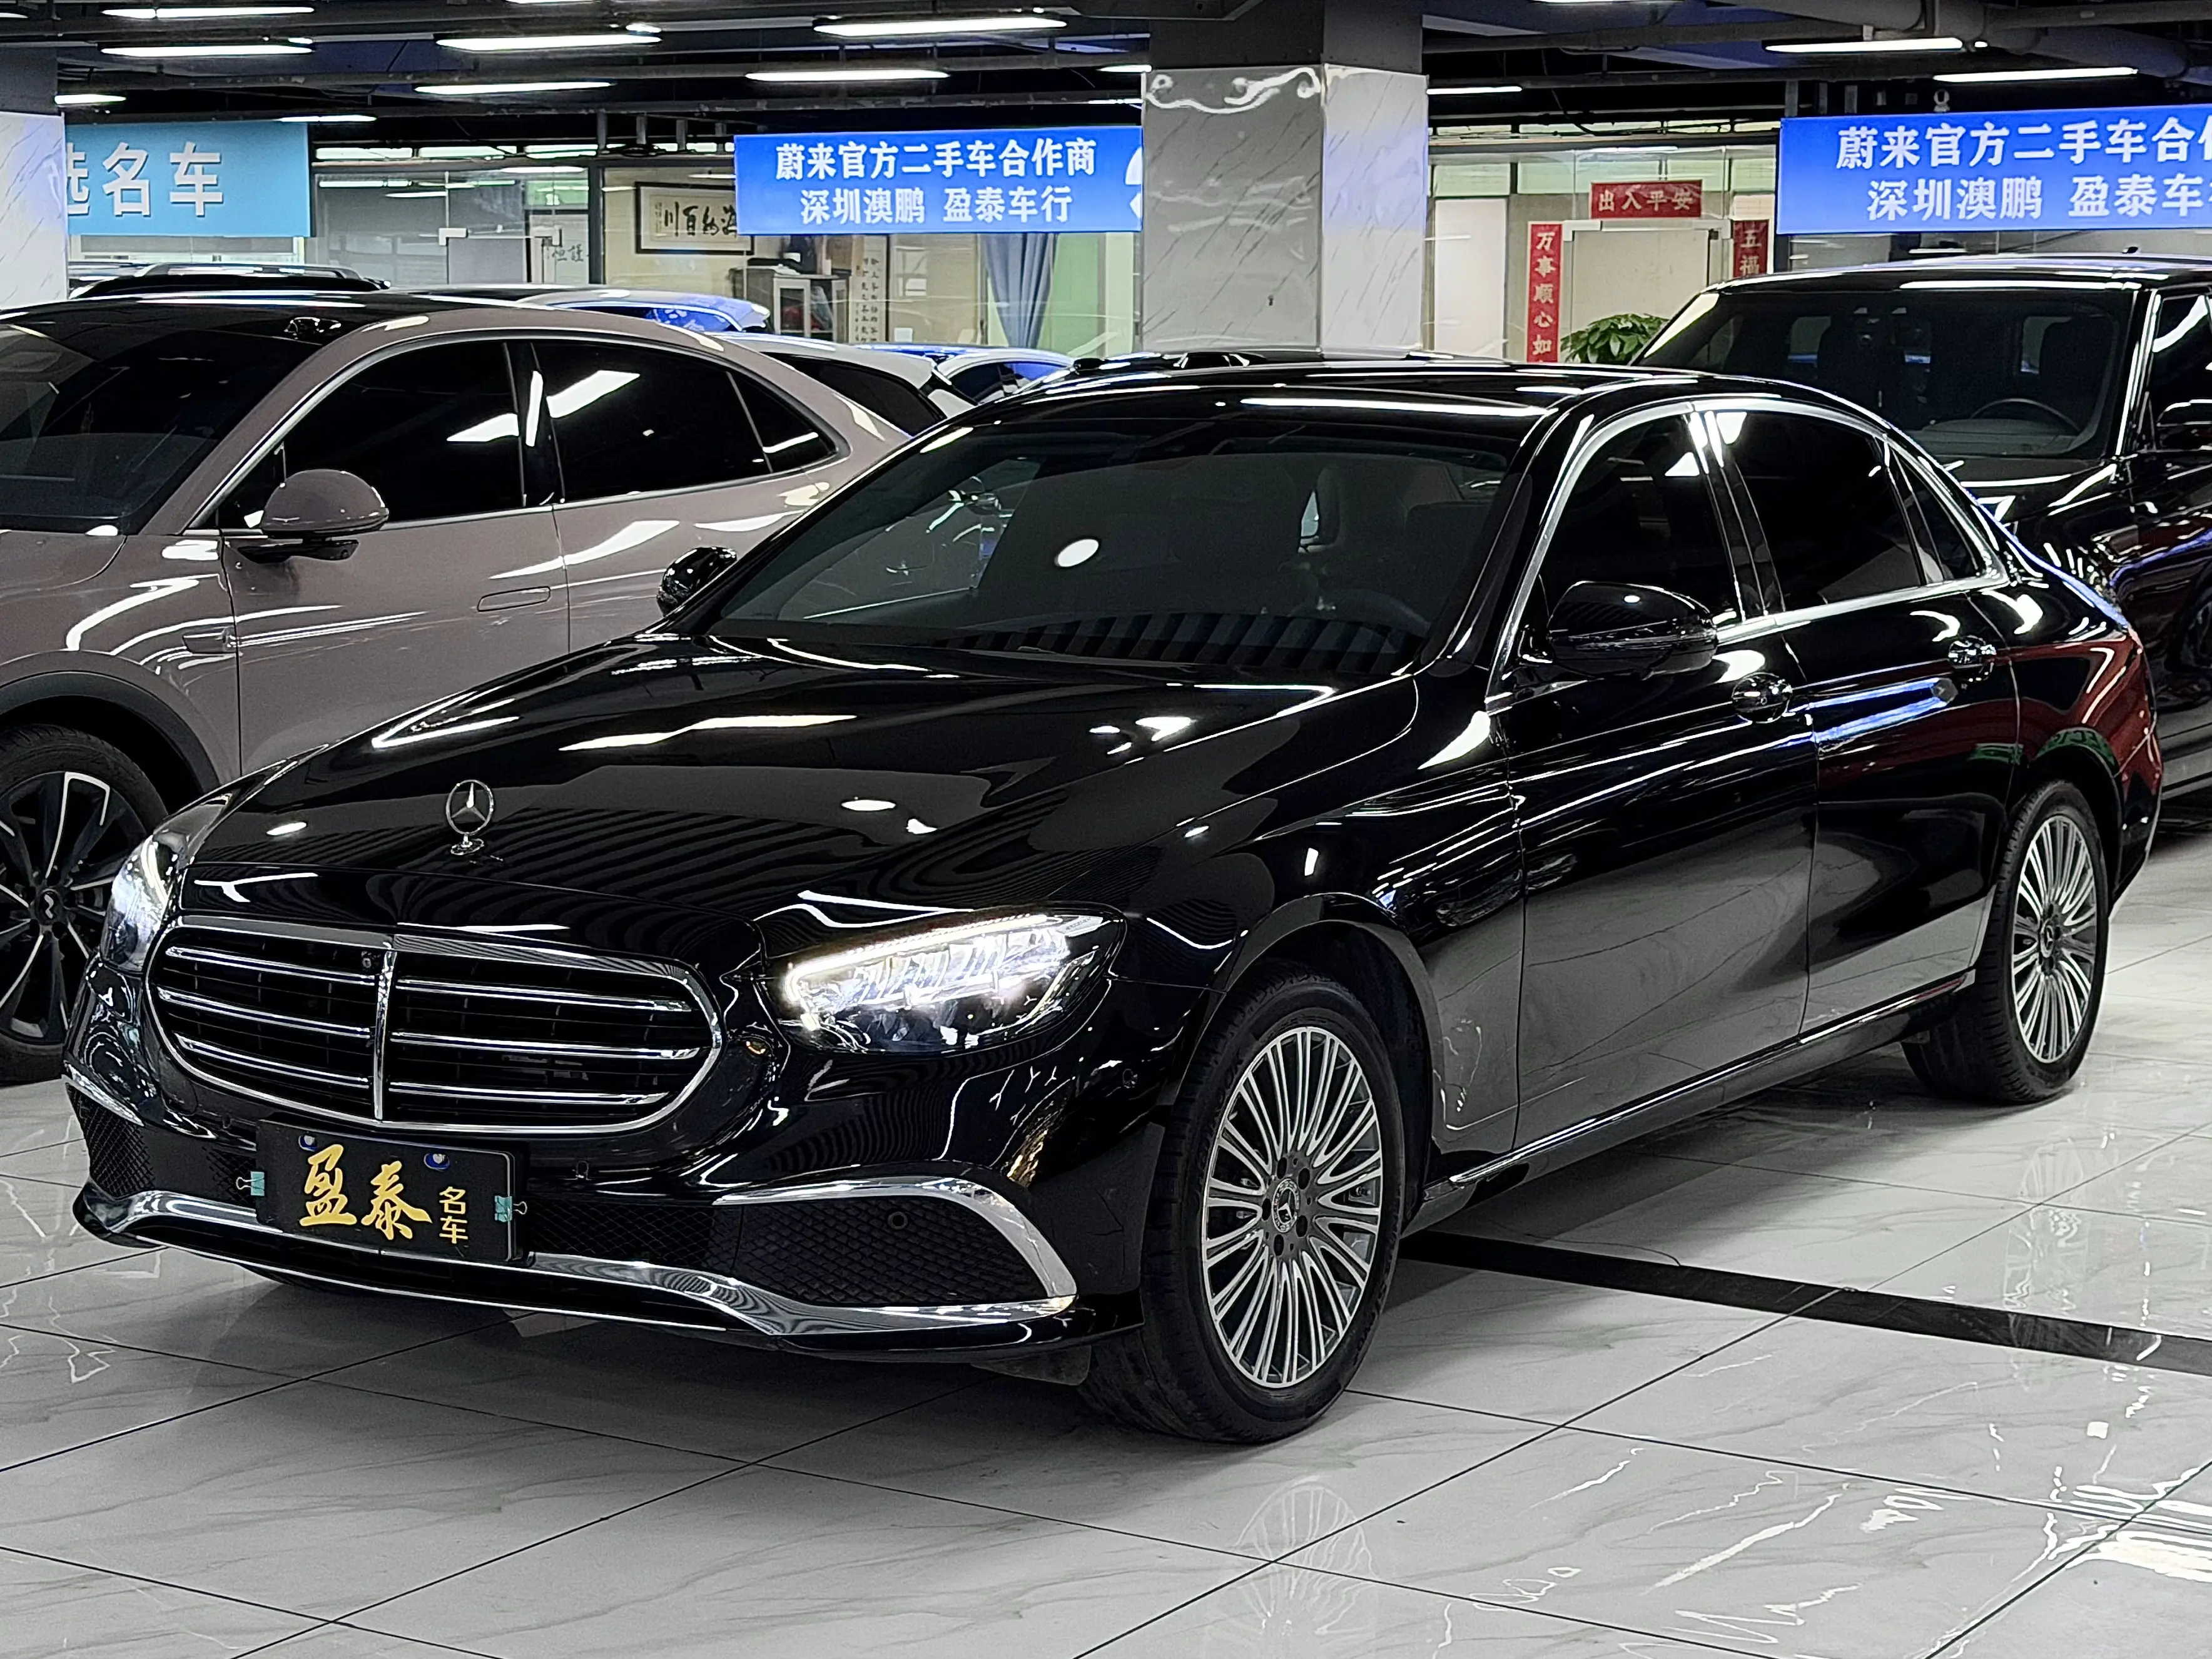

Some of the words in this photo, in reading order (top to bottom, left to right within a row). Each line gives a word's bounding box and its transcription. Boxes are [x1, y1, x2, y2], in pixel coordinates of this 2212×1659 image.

[776, 138, 1097, 180] 蔚来官方二手车合作商
[801, 186, 925, 225] 深圳澳鹏
[943, 185, 1072, 223] 盈泰车行
[1598, 185, 1693, 211] 出入平安
[1867, 176, 2042, 221] 深圳澳鹏
[2068, 173, 2212, 217] 盈泰车
[1740, 230, 1762, 276] 五福
[1532, 231, 1556, 362] 万事顺心如
[300, 1144, 433, 1240] 盈泰
[439, 1186, 469, 1244] 名车
